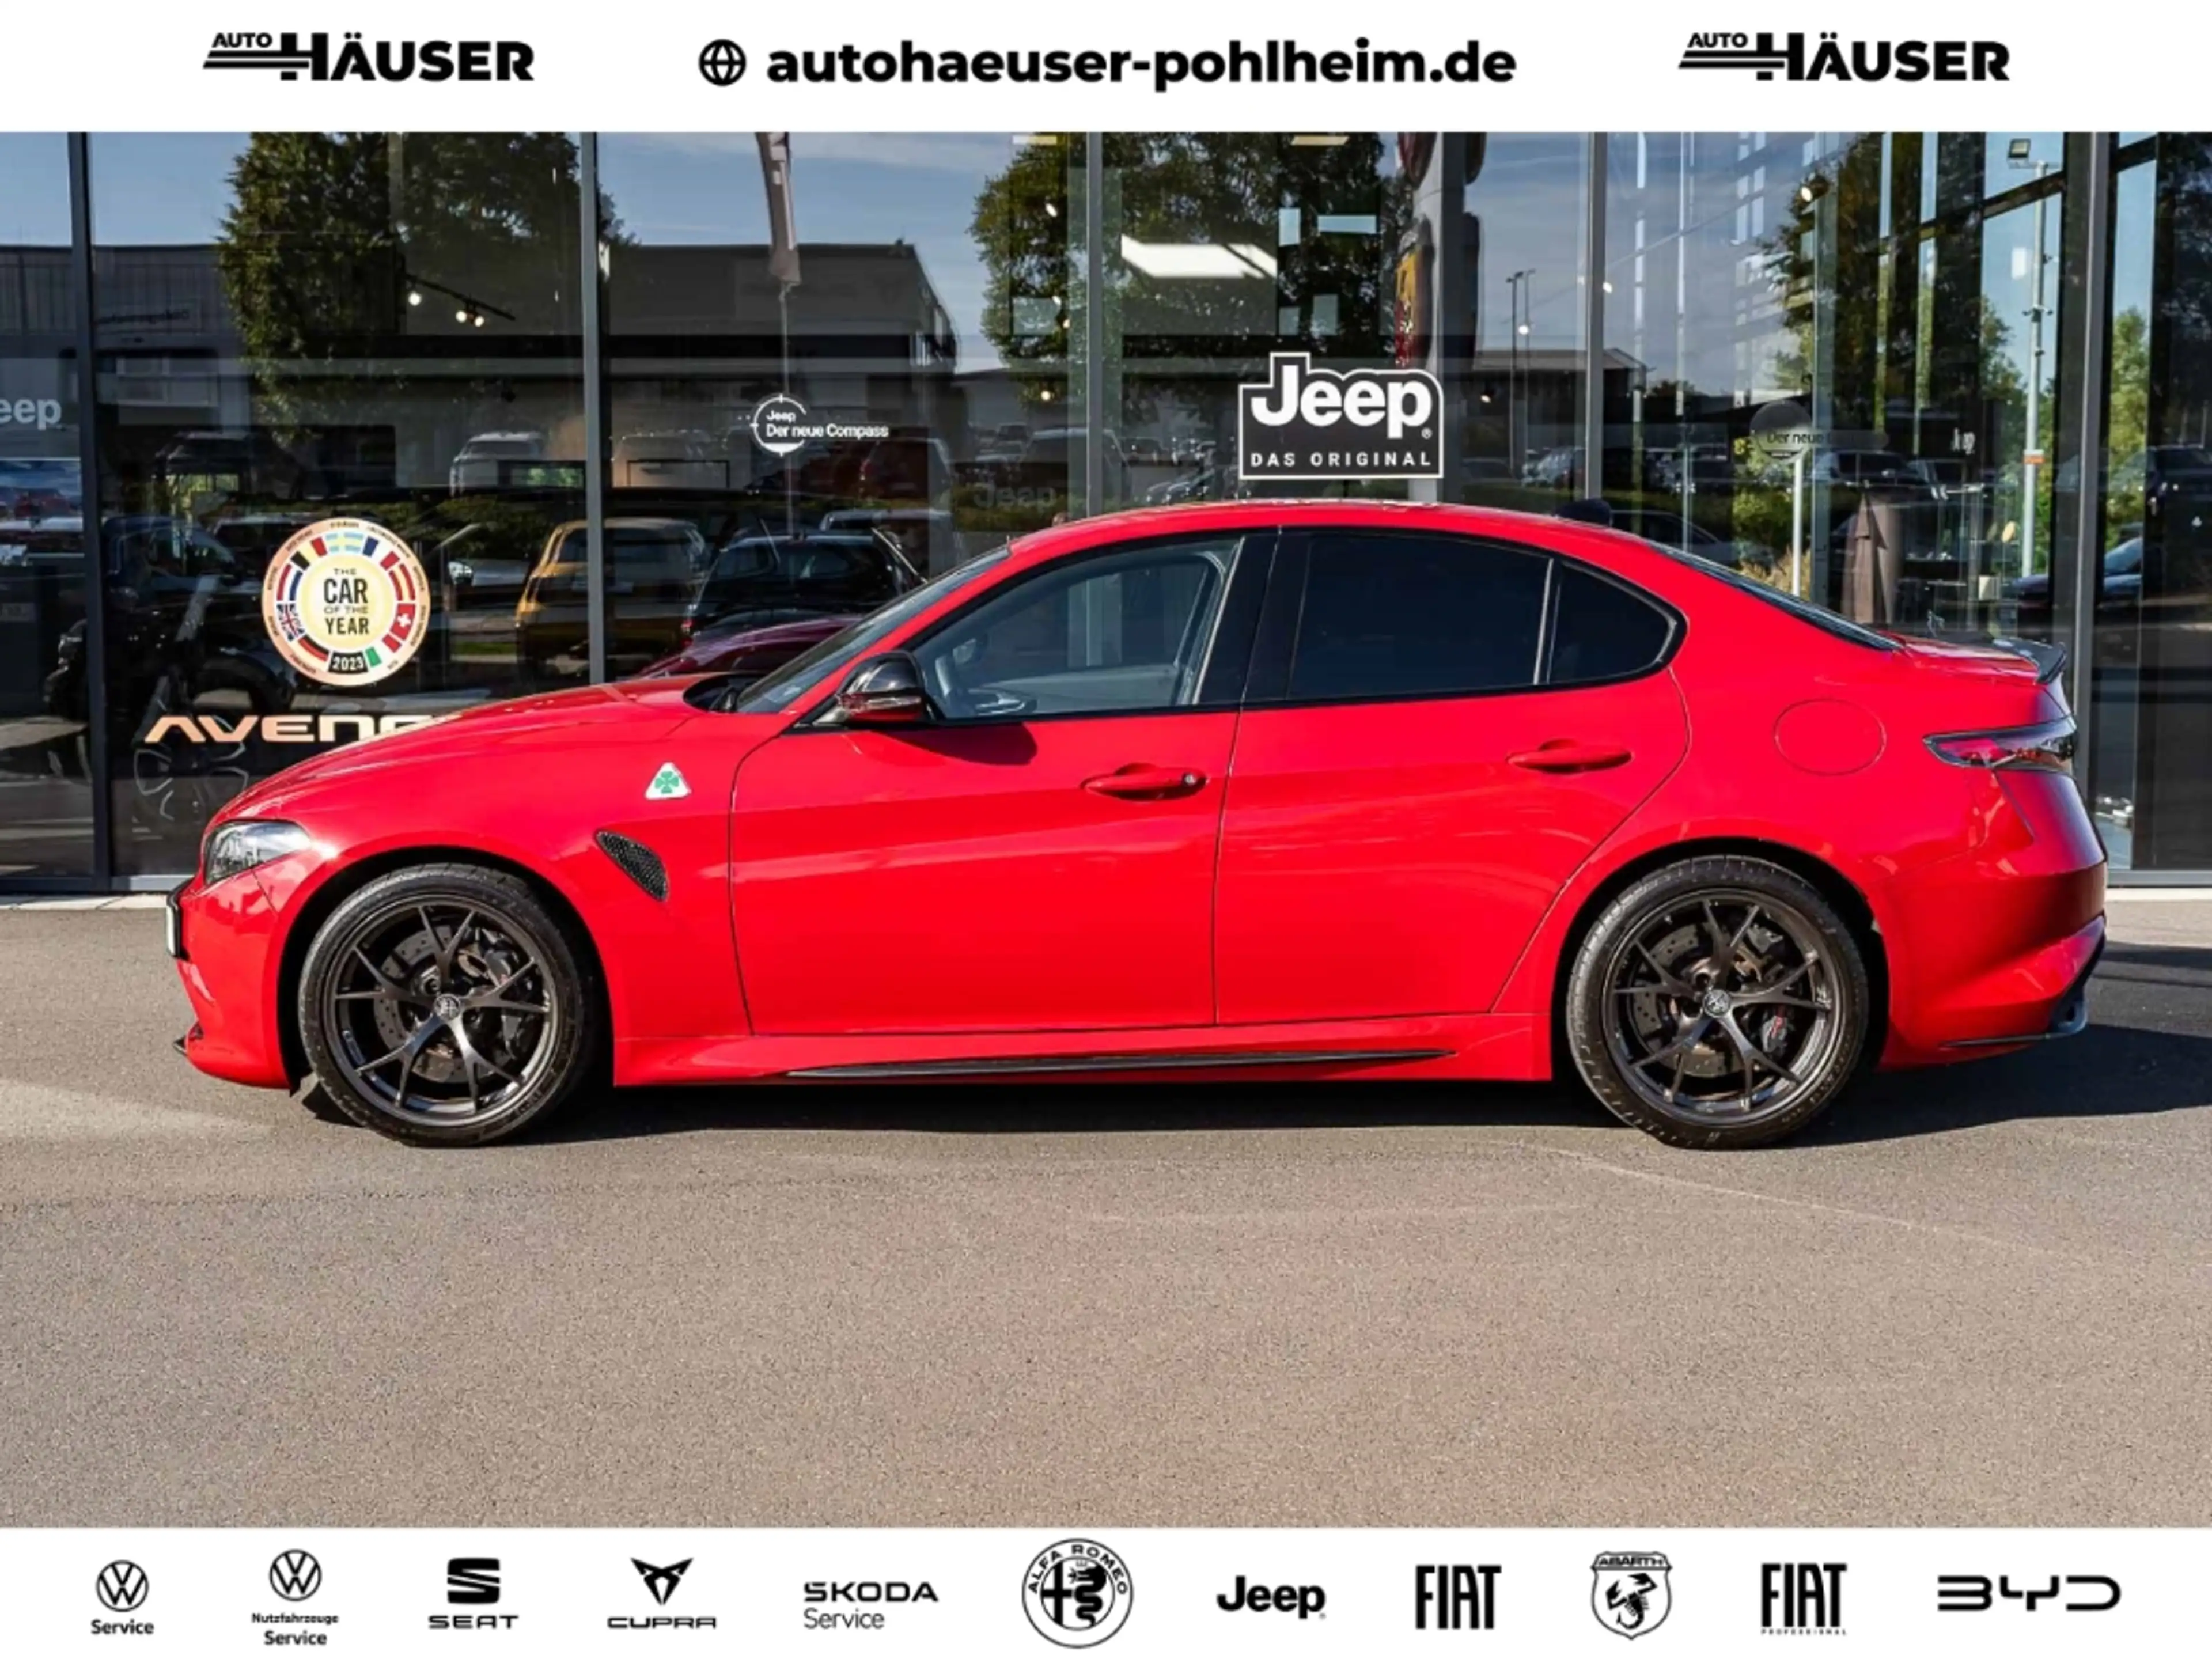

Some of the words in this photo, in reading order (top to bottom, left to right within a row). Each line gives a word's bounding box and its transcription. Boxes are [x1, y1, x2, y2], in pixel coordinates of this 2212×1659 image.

[1250, 365, 1433, 440] Jeep
[0, 399, 62, 431] eep
[766, 410, 796, 423] Jeep
[766, 424, 790, 438] Der
[791, 425, 824, 438] neue
[826, 423, 889, 441] Compass
[1250, 452, 1296, 467] DAS
[1310, 451, 1431, 467] ORIGINAL
[333, 567, 357, 575] THE
[323, 578, 369, 604] CAR
[323, 607, 342, 615] OF
[345, 607, 369, 615] THE
[324, 617, 370, 635] YEAR
[332, 656, 365, 671] 2023
